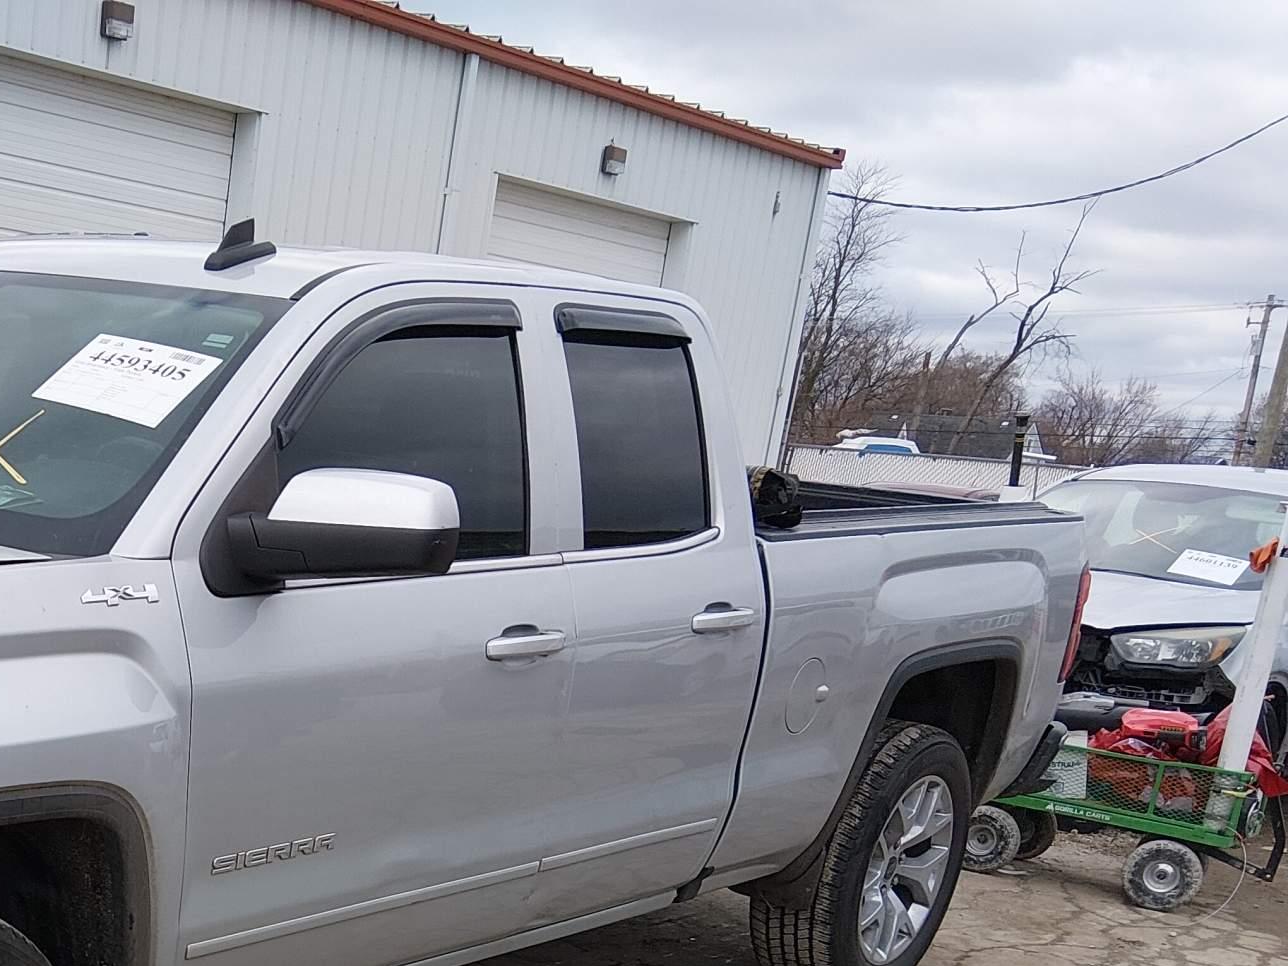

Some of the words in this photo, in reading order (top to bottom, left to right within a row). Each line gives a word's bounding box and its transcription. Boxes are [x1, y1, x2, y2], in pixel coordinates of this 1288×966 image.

[89, 350, 192, 382] 44593405
[1054, 804, 1084, 816] GORILLA
[211, 832, 337, 875] SIERRA
